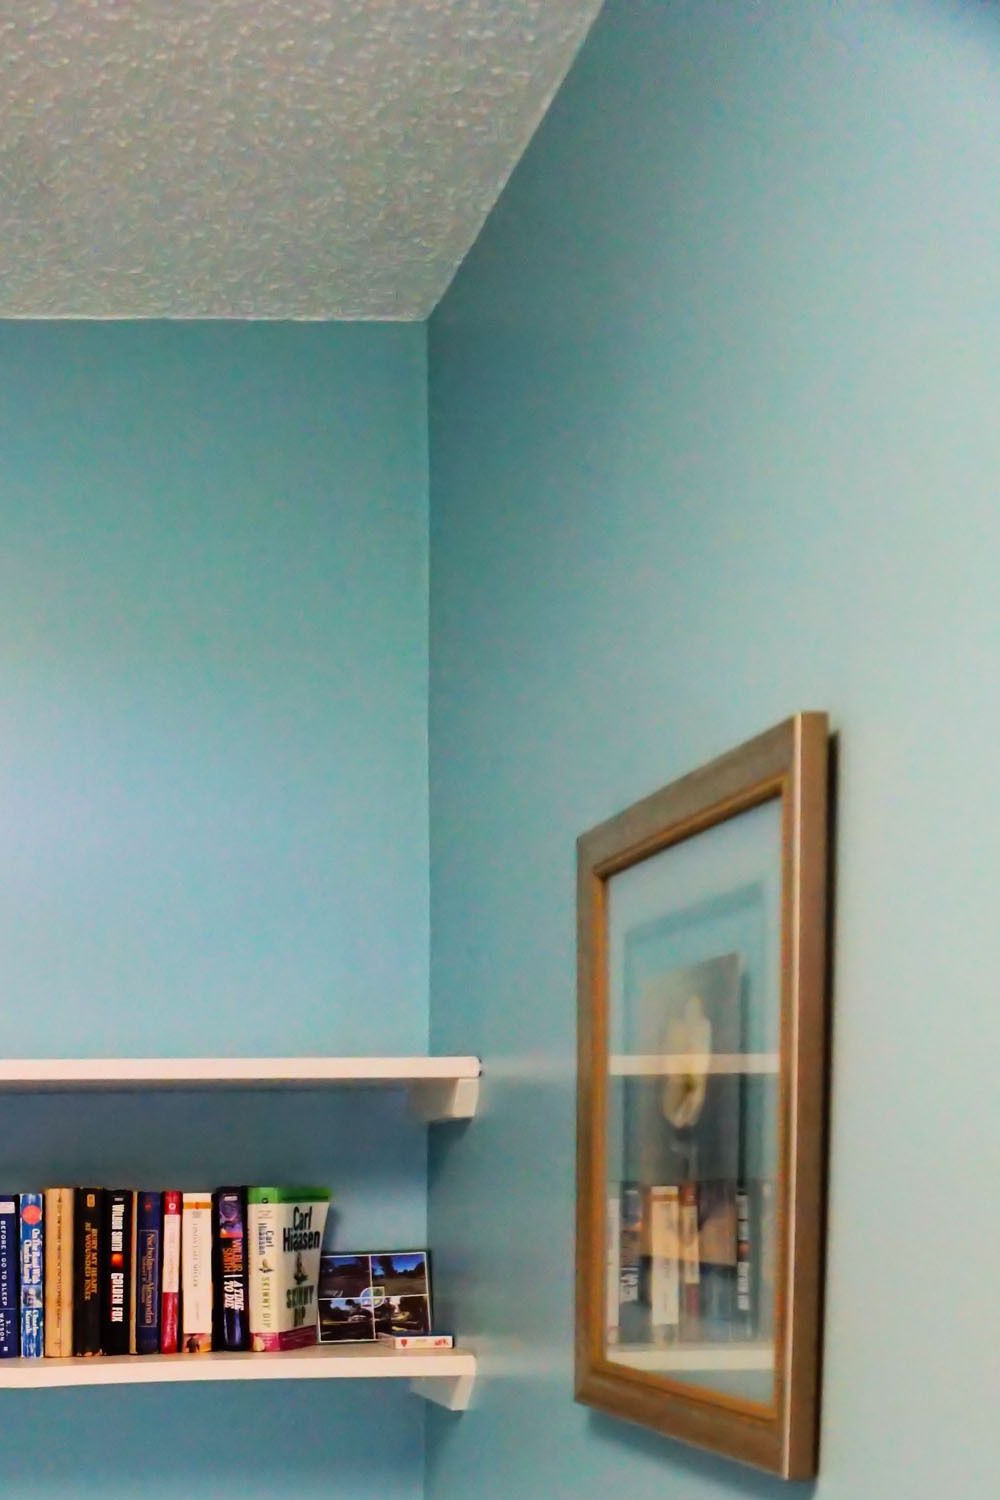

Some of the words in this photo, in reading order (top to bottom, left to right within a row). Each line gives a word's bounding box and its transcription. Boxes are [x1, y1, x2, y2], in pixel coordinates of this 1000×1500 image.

[112, 1204, 124, 1230] WILBUR
[293, 1206, 312, 1231] Carl
[112, 1231, 123, 1252] SMITH
[265, 1230, 274, 1248] Carl
[283, 1227, 320, 1252] Hiaasen
[1, 1270, 7, 1282] TO
[224, 1281, 234, 1291] TO
[111, 1272, 124, 1304] GOLDEN
[286, 1285, 314, 1309] SKINNY
[224, 1293, 234, 1309] DIE
[111, 1307, 124, 1322] FOX
